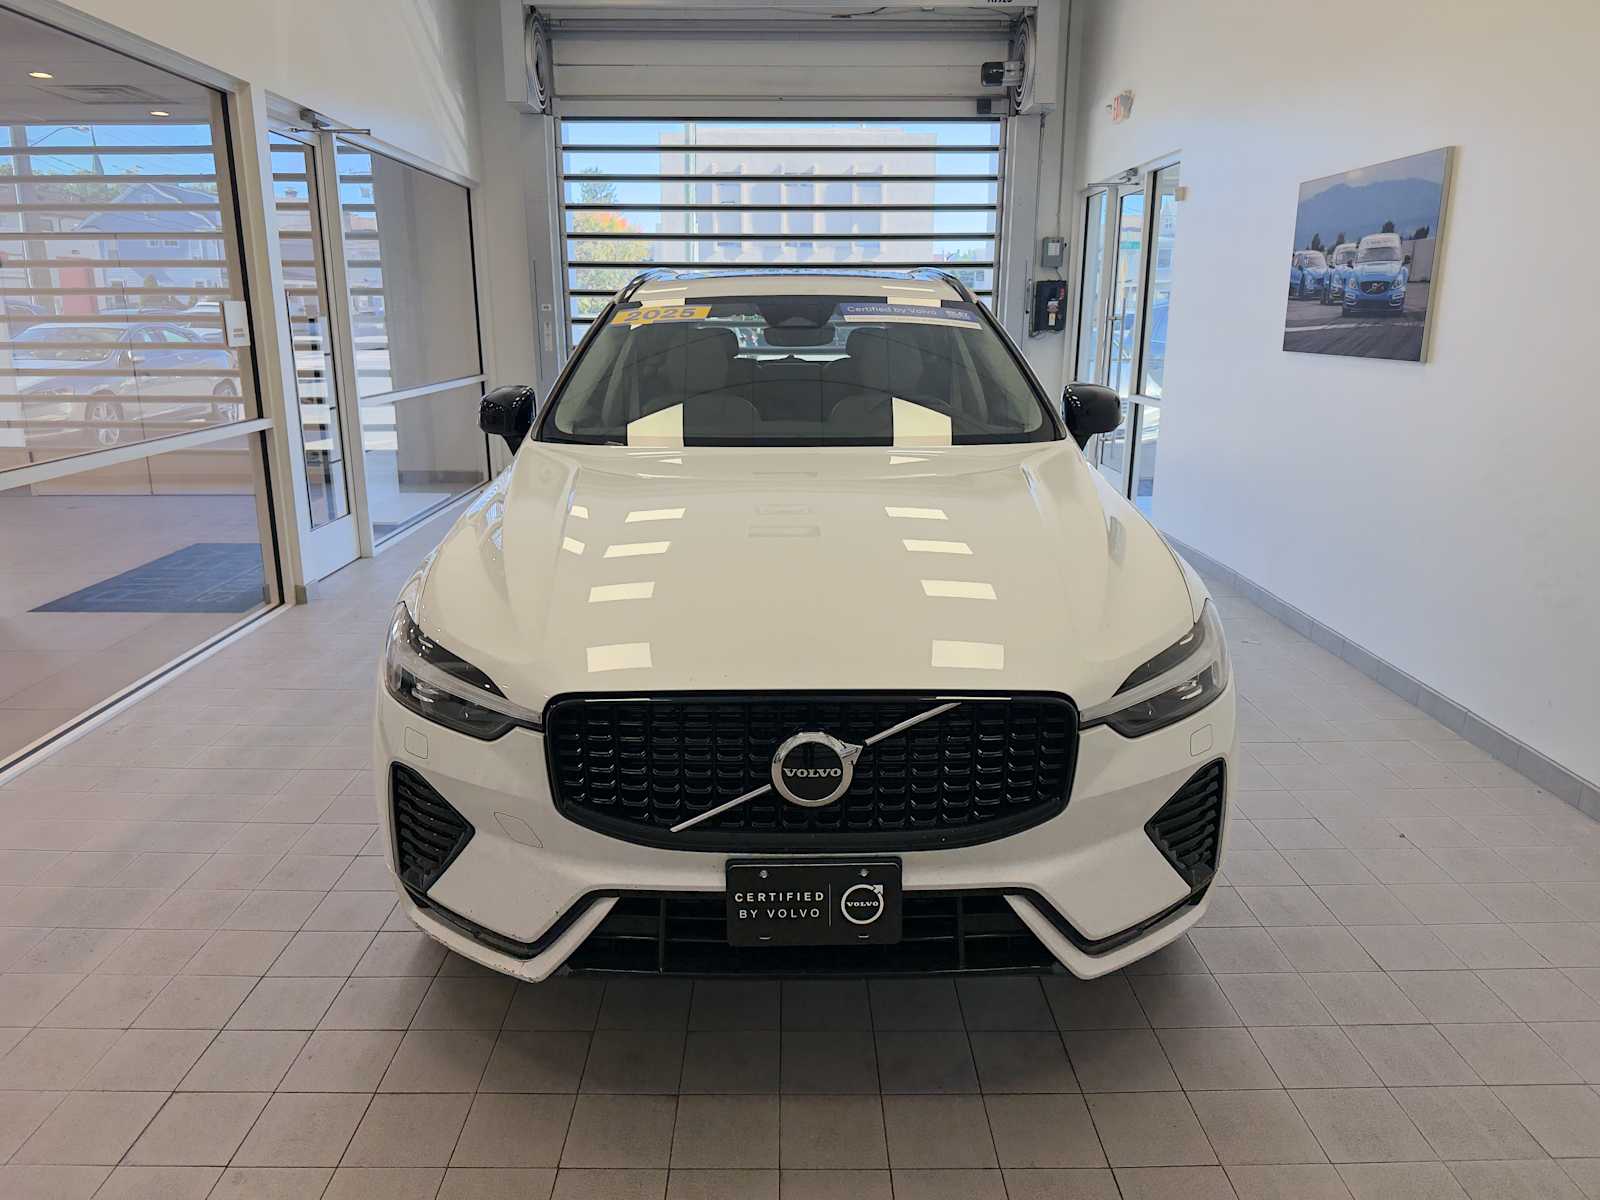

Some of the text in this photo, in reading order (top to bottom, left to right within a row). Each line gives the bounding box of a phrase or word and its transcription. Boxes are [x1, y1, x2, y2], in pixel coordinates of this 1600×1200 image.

[624, 308, 696, 321] 2025
[847, 305, 893, 313] Certified
[893, 306, 906, 314] by
[783, 768, 842, 777] VOLVO
[734, 892, 824, 902] CERTIFIED
[739, 908, 820, 918] BY VOLVO
